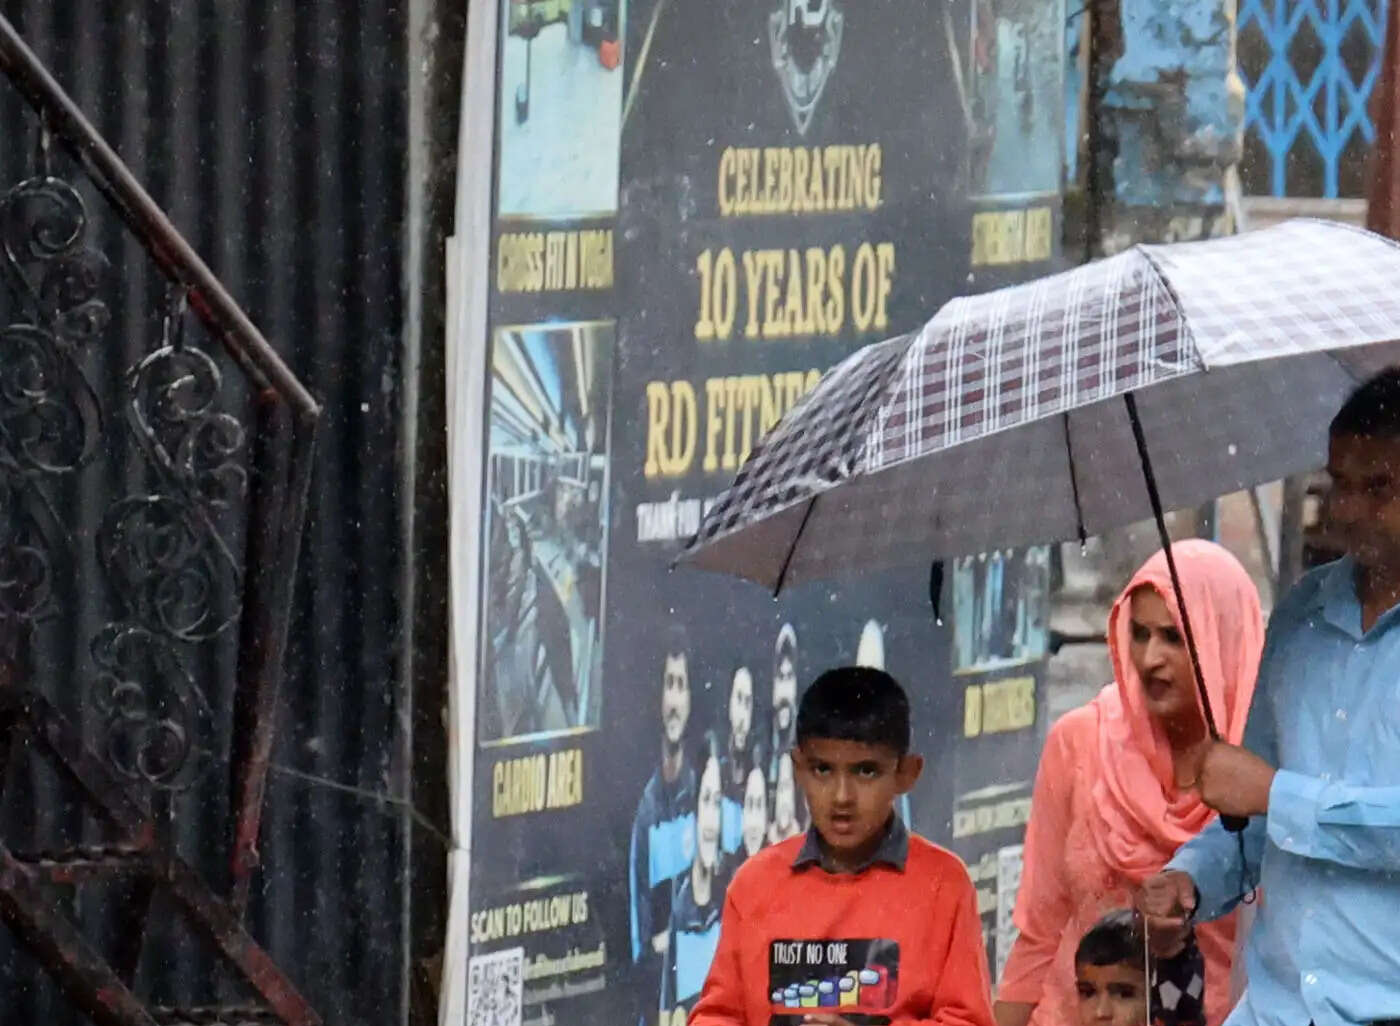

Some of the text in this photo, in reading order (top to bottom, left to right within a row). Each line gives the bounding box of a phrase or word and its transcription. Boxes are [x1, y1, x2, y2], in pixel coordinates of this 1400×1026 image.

[718, 144, 882, 216] CELEBRATING
[694, 242, 895, 339] 10 YEARS OF
[645, 368, 822, 478] RD FITN
[493, 749, 582, 818] CARDIO AREA
[470, 891, 588, 944] SCAN TO FOLLOW US
[773, 943, 848, 965] TRUST NO ONE
